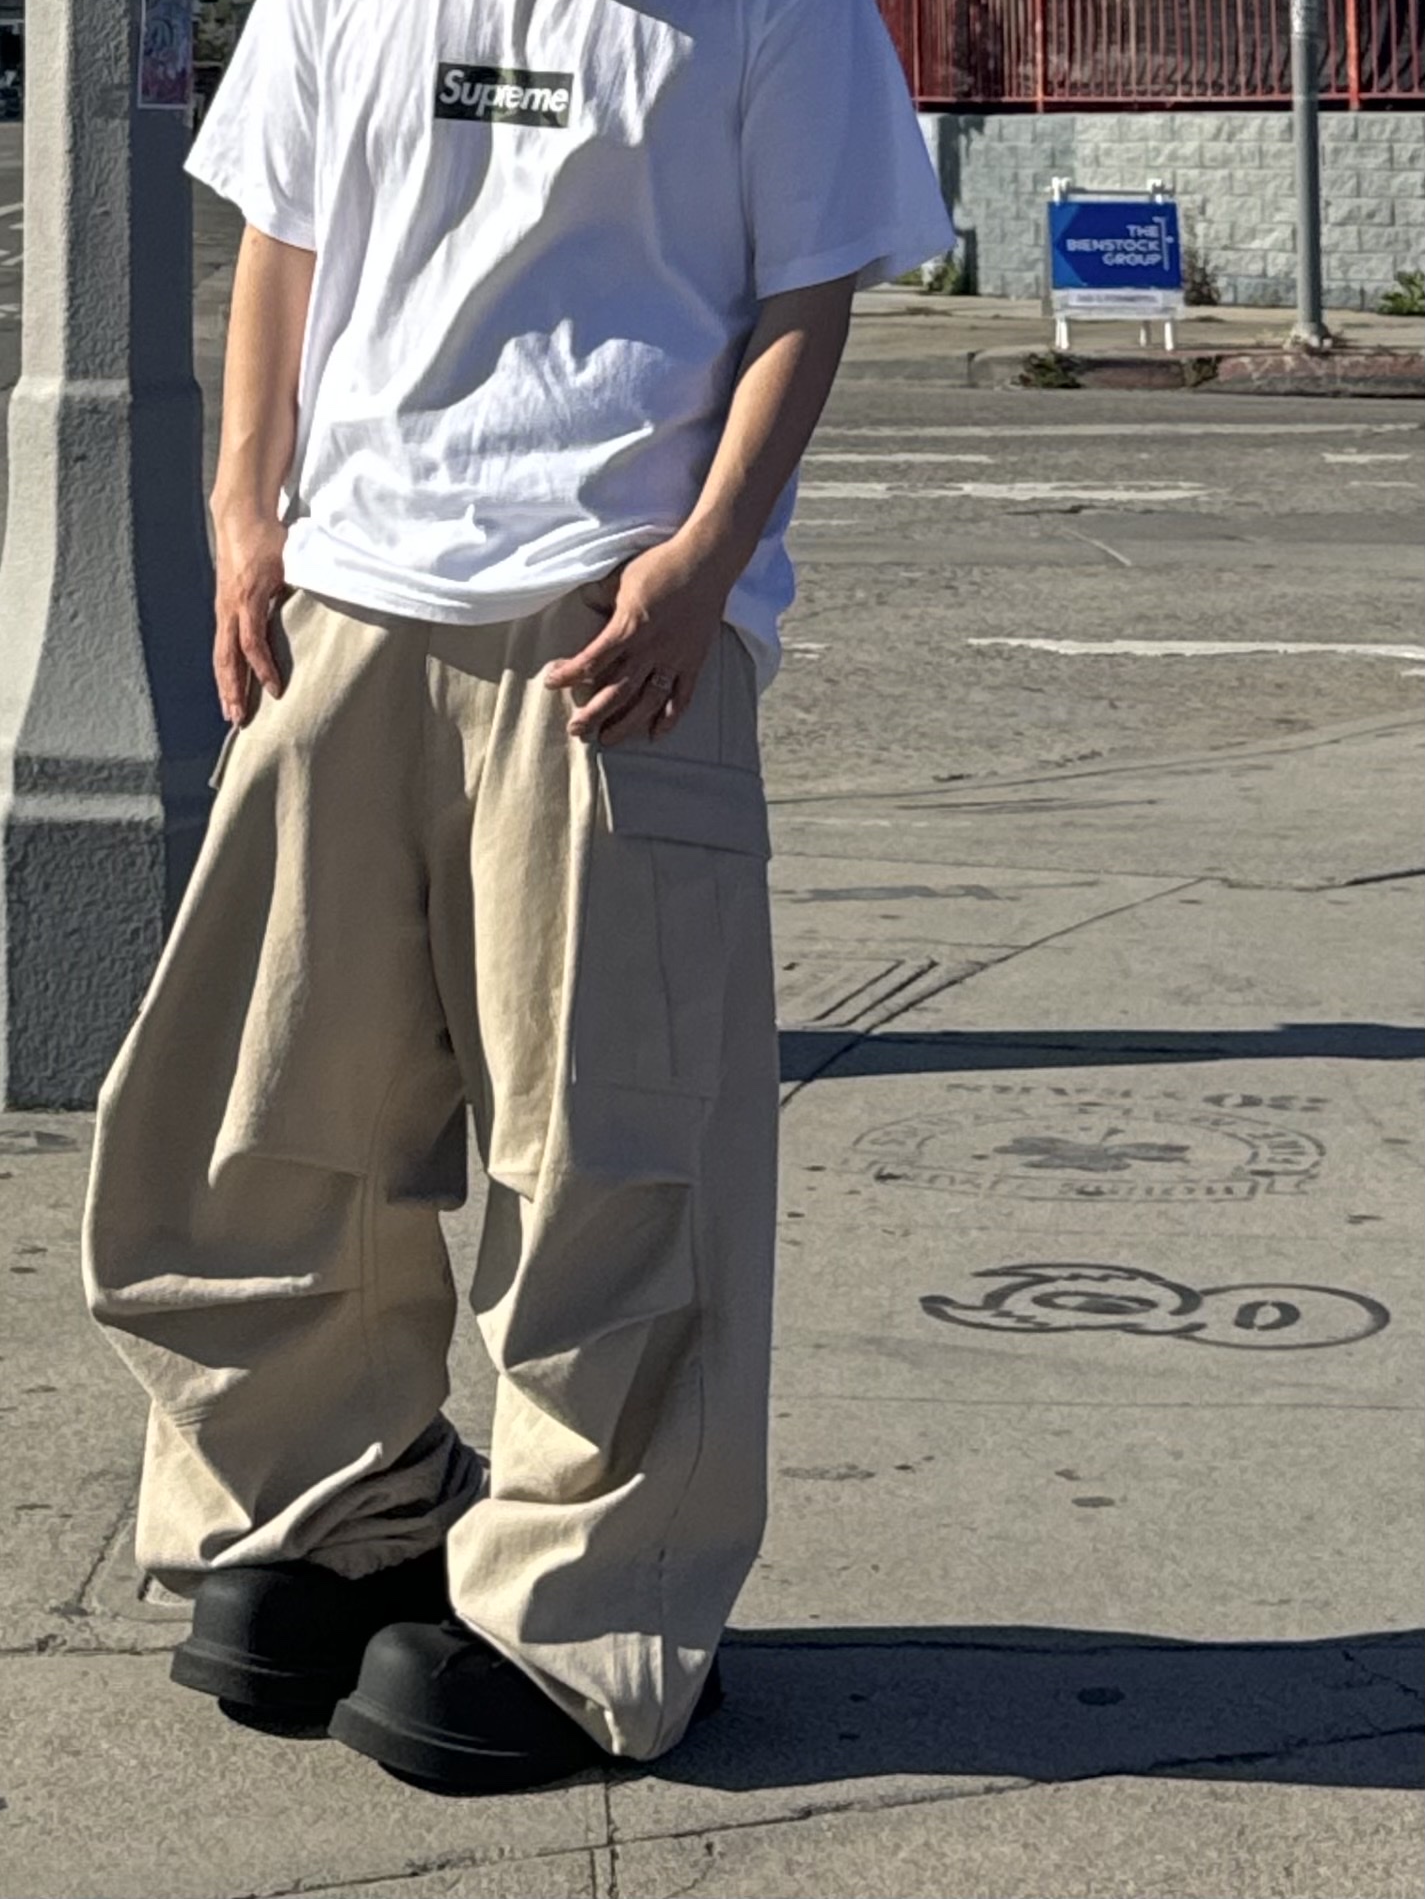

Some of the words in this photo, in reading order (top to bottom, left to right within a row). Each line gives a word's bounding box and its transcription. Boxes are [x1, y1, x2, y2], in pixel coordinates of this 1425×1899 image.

[439, 69, 569, 117] Supreme
[1126, 224, 1159, 239] THE
[1102, 253, 1163, 267] GROUP
